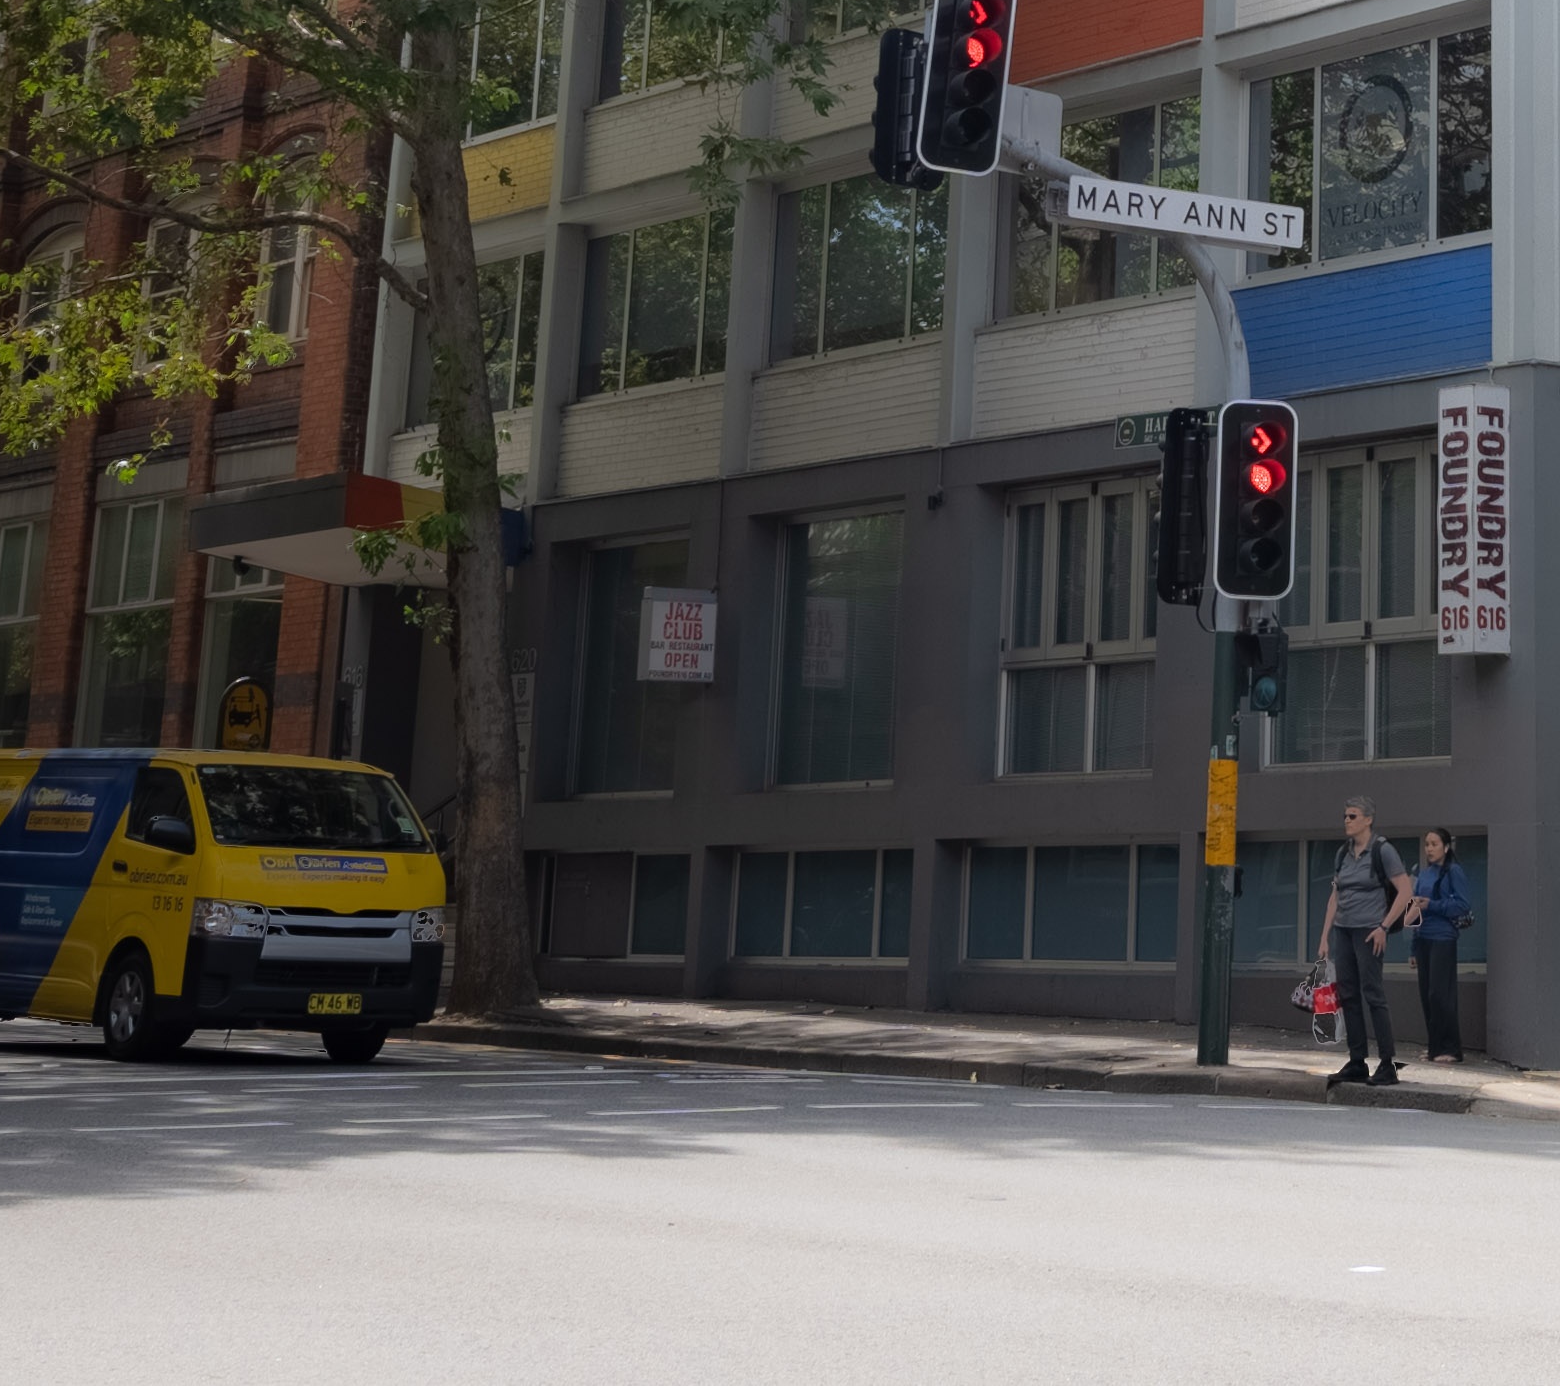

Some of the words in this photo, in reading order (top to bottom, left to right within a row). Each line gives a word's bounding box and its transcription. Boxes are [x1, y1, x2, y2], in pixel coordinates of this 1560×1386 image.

[1077, 185, 1167, 220] MARY
[1183, 201, 1246, 232] ANN
[1263, 212, 1296, 238] ST
[1328, 191, 1422, 228] VELOCITY
[1441, 406, 1469, 598] FOUNDRY
[1477, 405, 1506, 600] FOUNDRY
[666, 602, 702, 621] JAZZ
[1441, 606, 1469, 631] 616
[1477, 605, 1506, 631] 616
[663, 621, 703, 640] CLUB
[669, 641, 713, 652] RESTAURANT
[665, 652, 699, 668] OPEN
